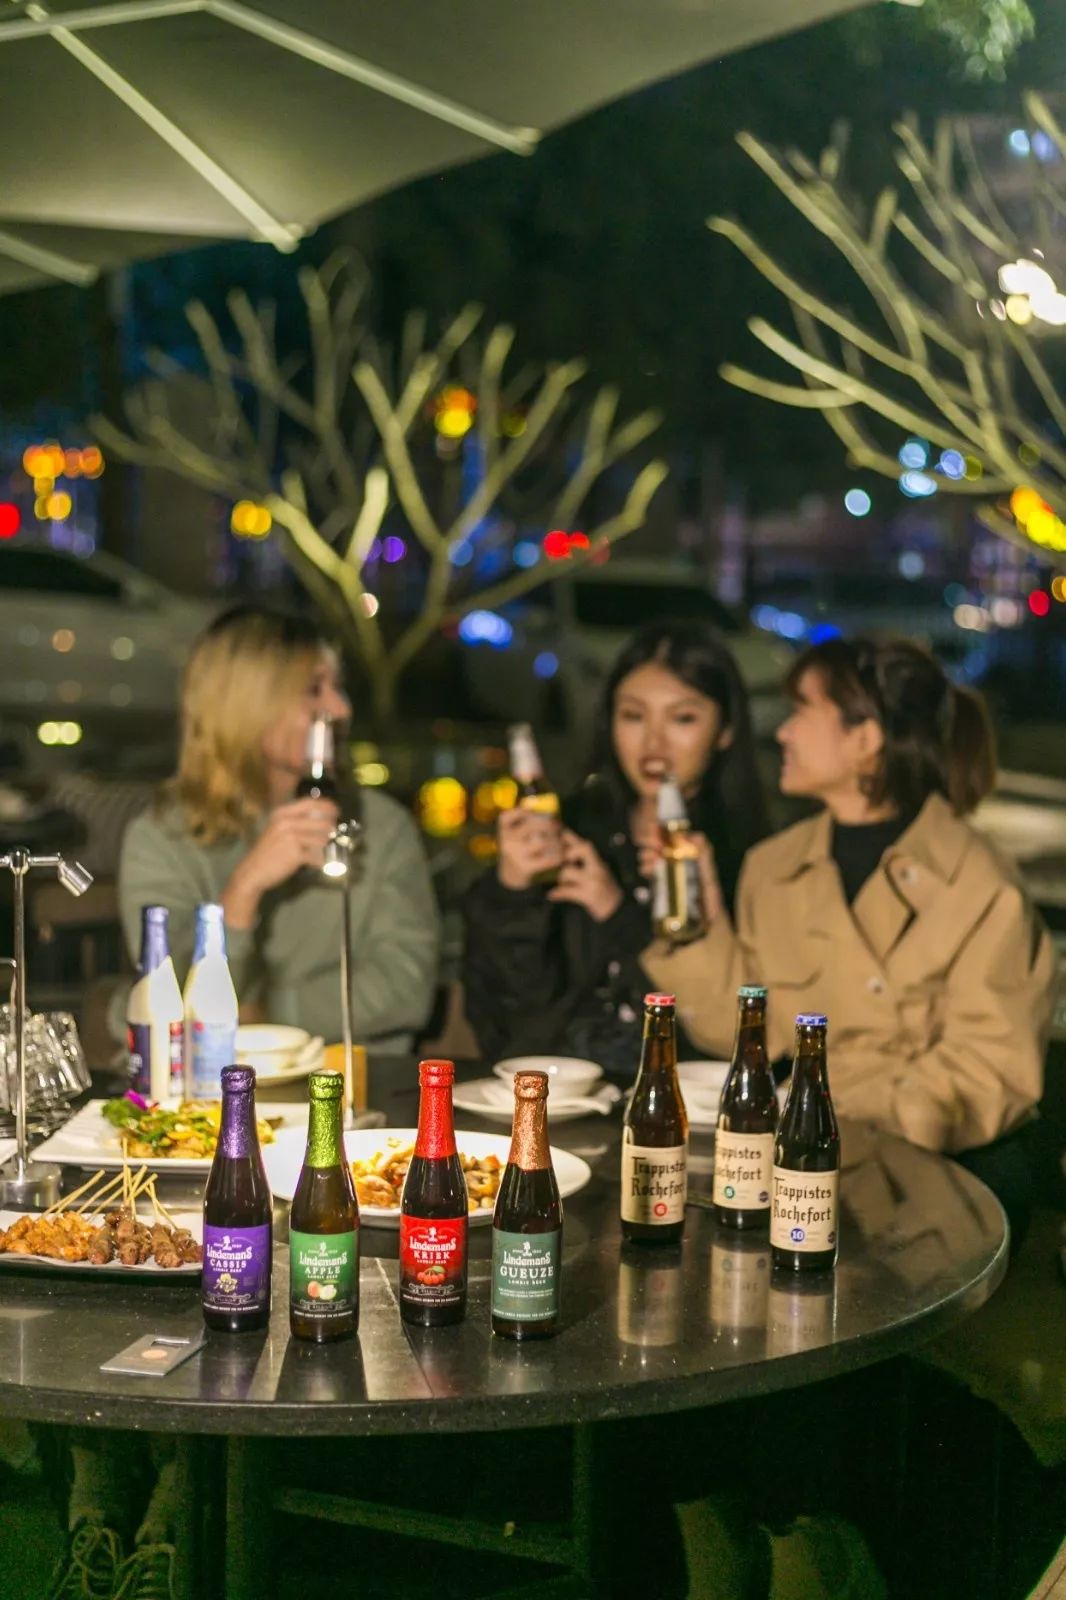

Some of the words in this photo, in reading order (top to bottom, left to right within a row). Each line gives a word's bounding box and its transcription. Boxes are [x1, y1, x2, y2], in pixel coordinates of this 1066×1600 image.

[773, 1176, 832, 1202] Trappistes
[773, 1199, 832, 1225] Rochefort
[414, 1251, 450, 1259] KRIEK
[209, 1259, 247, 1269] CASSIS
[304, 1266, 341, 1275] APPLE
[499, 1265, 554, 1279] GUEUZE
